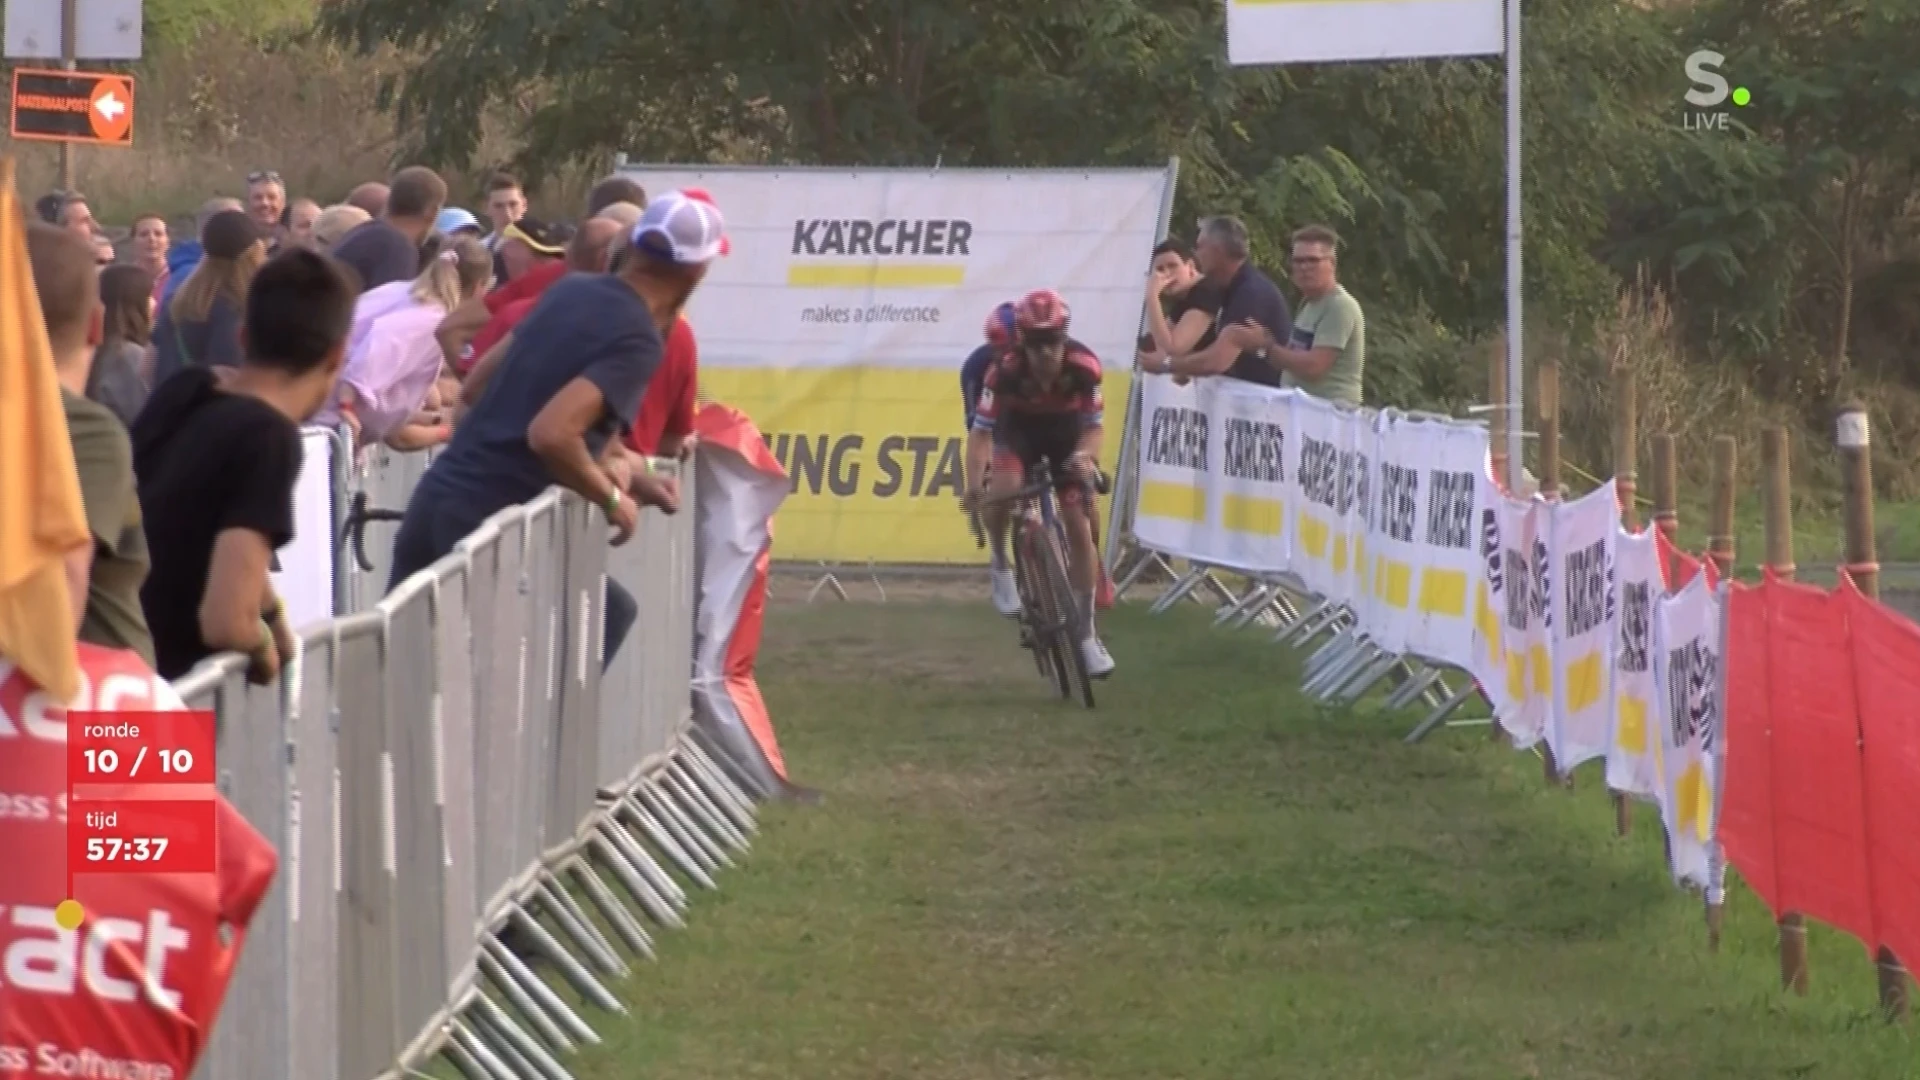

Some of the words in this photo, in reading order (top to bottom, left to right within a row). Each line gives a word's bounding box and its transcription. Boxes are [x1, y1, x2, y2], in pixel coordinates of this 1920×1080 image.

[791, 219, 973, 256] KÄRCHER
[801, 305, 850, 323] makes
[853, 307, 863, 322] a
[865, 304, 941, 323] difference
[762, 433, 863, 496] ING
[0, 905, 190, 1012] act
